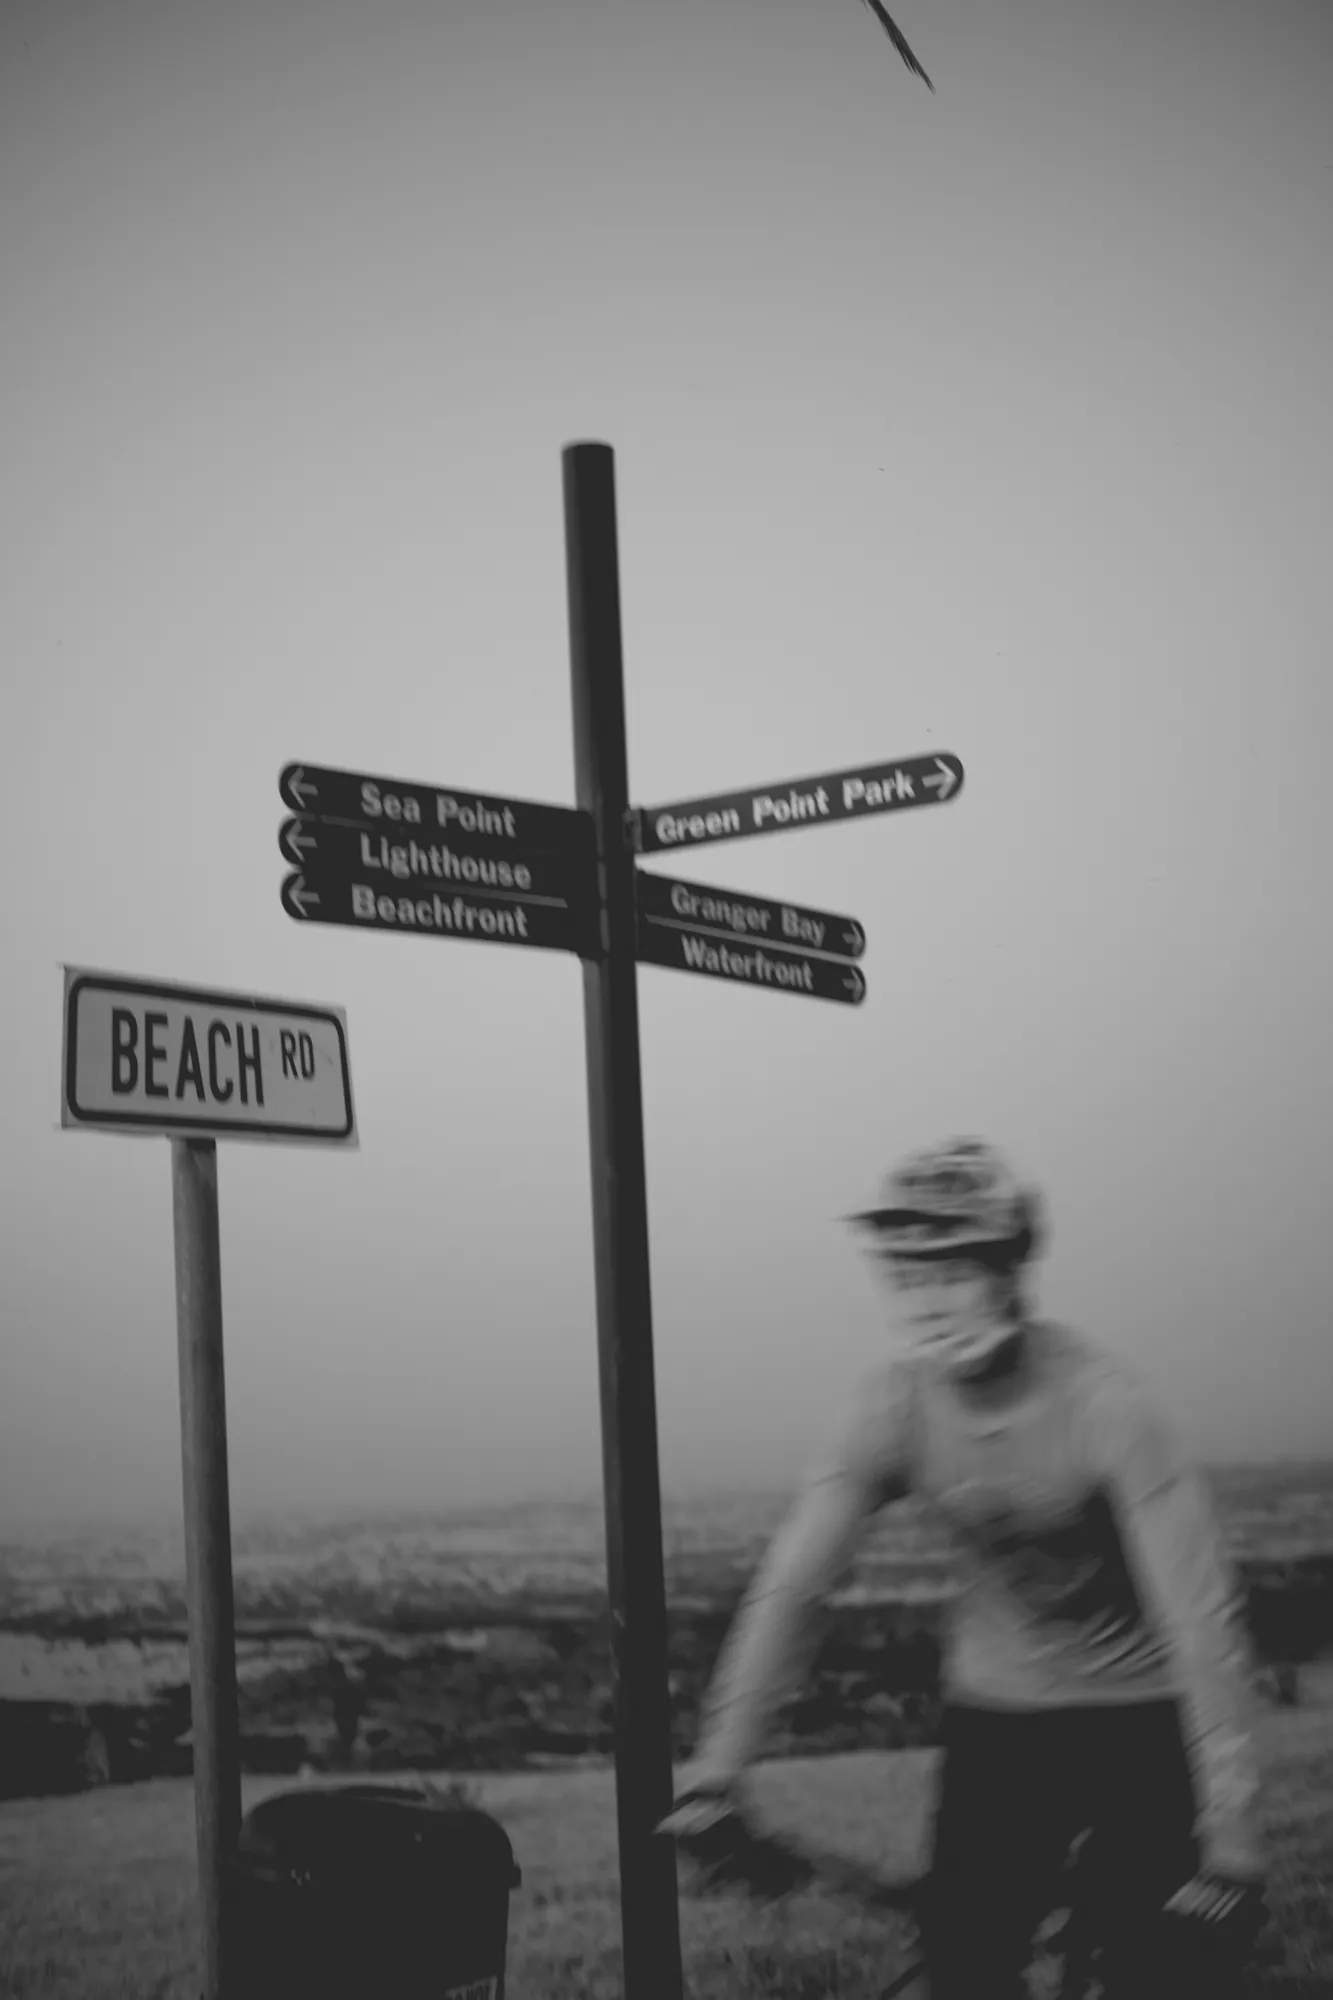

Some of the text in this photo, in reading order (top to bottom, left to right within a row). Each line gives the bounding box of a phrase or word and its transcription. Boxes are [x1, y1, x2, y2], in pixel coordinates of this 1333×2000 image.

[361, 782, 516, 838] Sea Point
[656, 769, 916, 844] Green Point Park
[361, 832, 532, 890] Lighthouse
[352, 883, 529, 937] Beachfront
[670, 883, 826, 947] Granger Bay
[681, 934, 814, 990] Waterfront
[111, 1006, 315, 1107] BEACH RD
